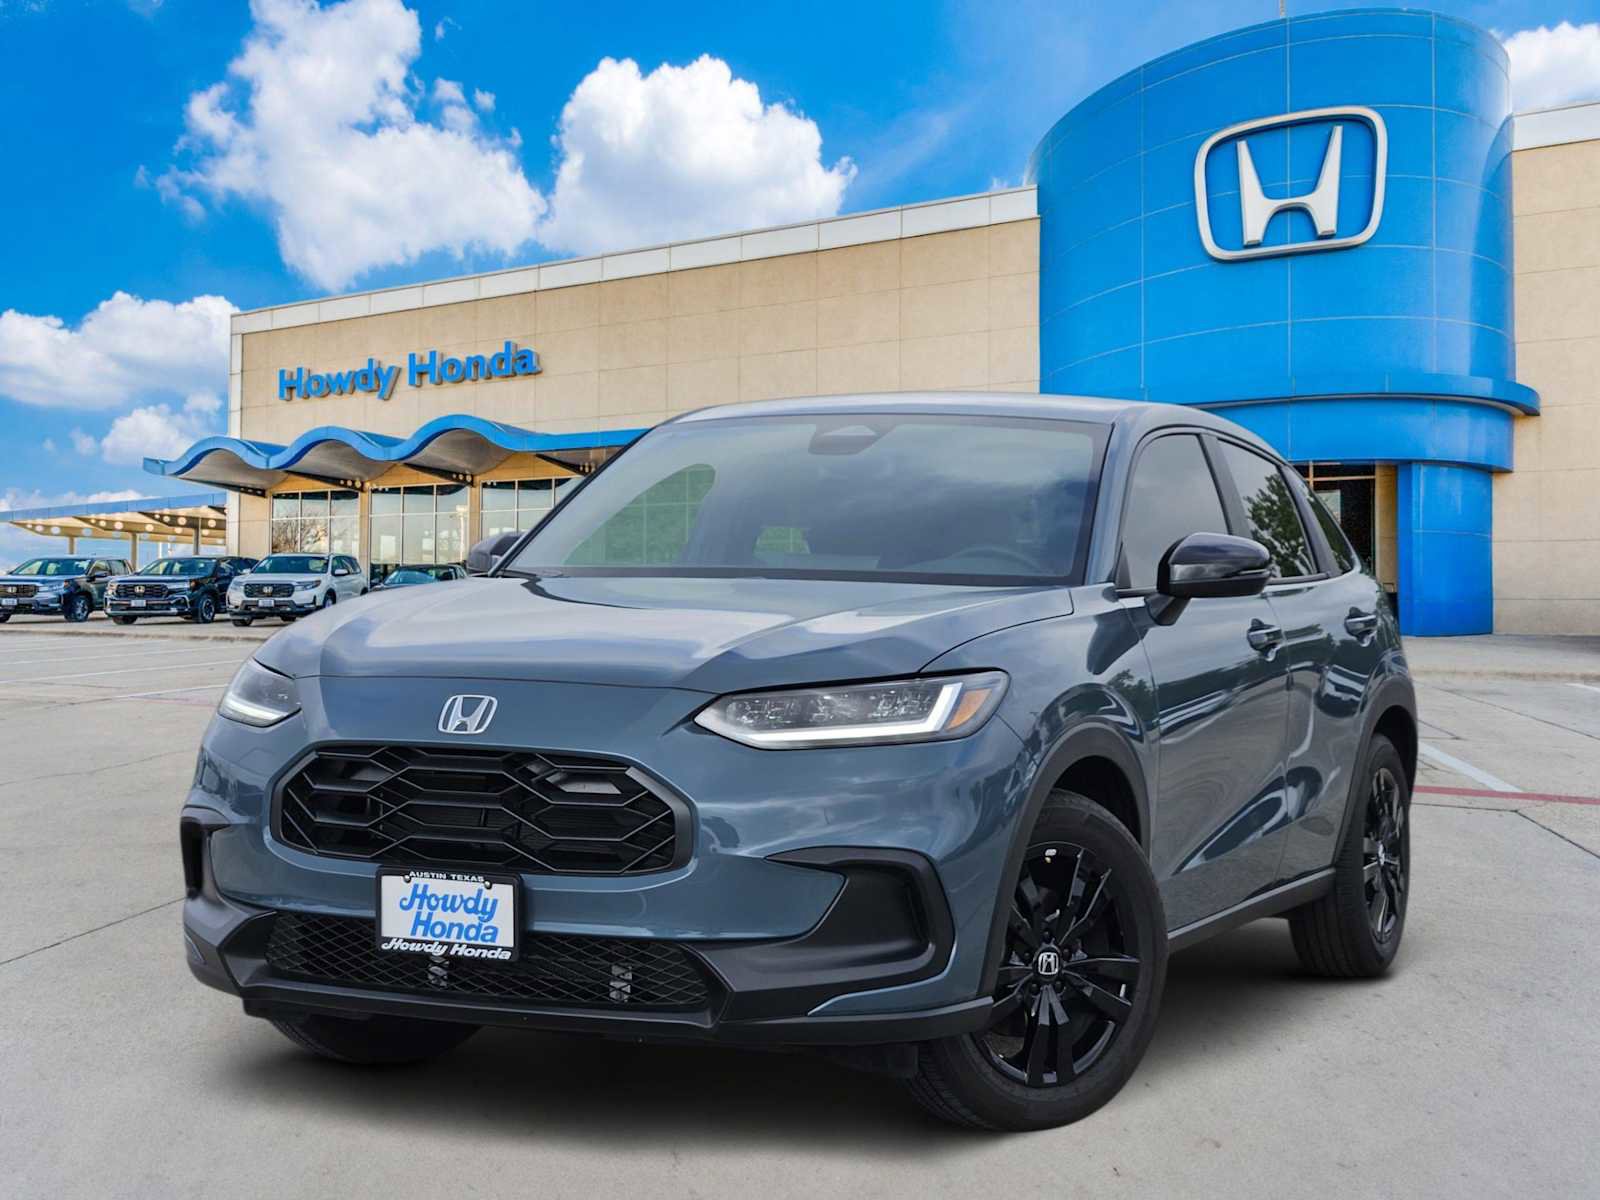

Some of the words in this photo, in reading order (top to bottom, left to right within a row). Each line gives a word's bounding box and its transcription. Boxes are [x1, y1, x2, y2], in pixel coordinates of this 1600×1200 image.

[278, 358, 400, 400] Howdy
[408, 341, 541, 387] Honda
[409, 871, 446, 880] AUSTIN
[450, 874, 485, 882] TEXAS
[400, 883, 498, 922] Howdy
[410, 911, 499, 944] Honda
[381, 938, 449, 956] Howdy
[450, 944, 512, 960] Honda
